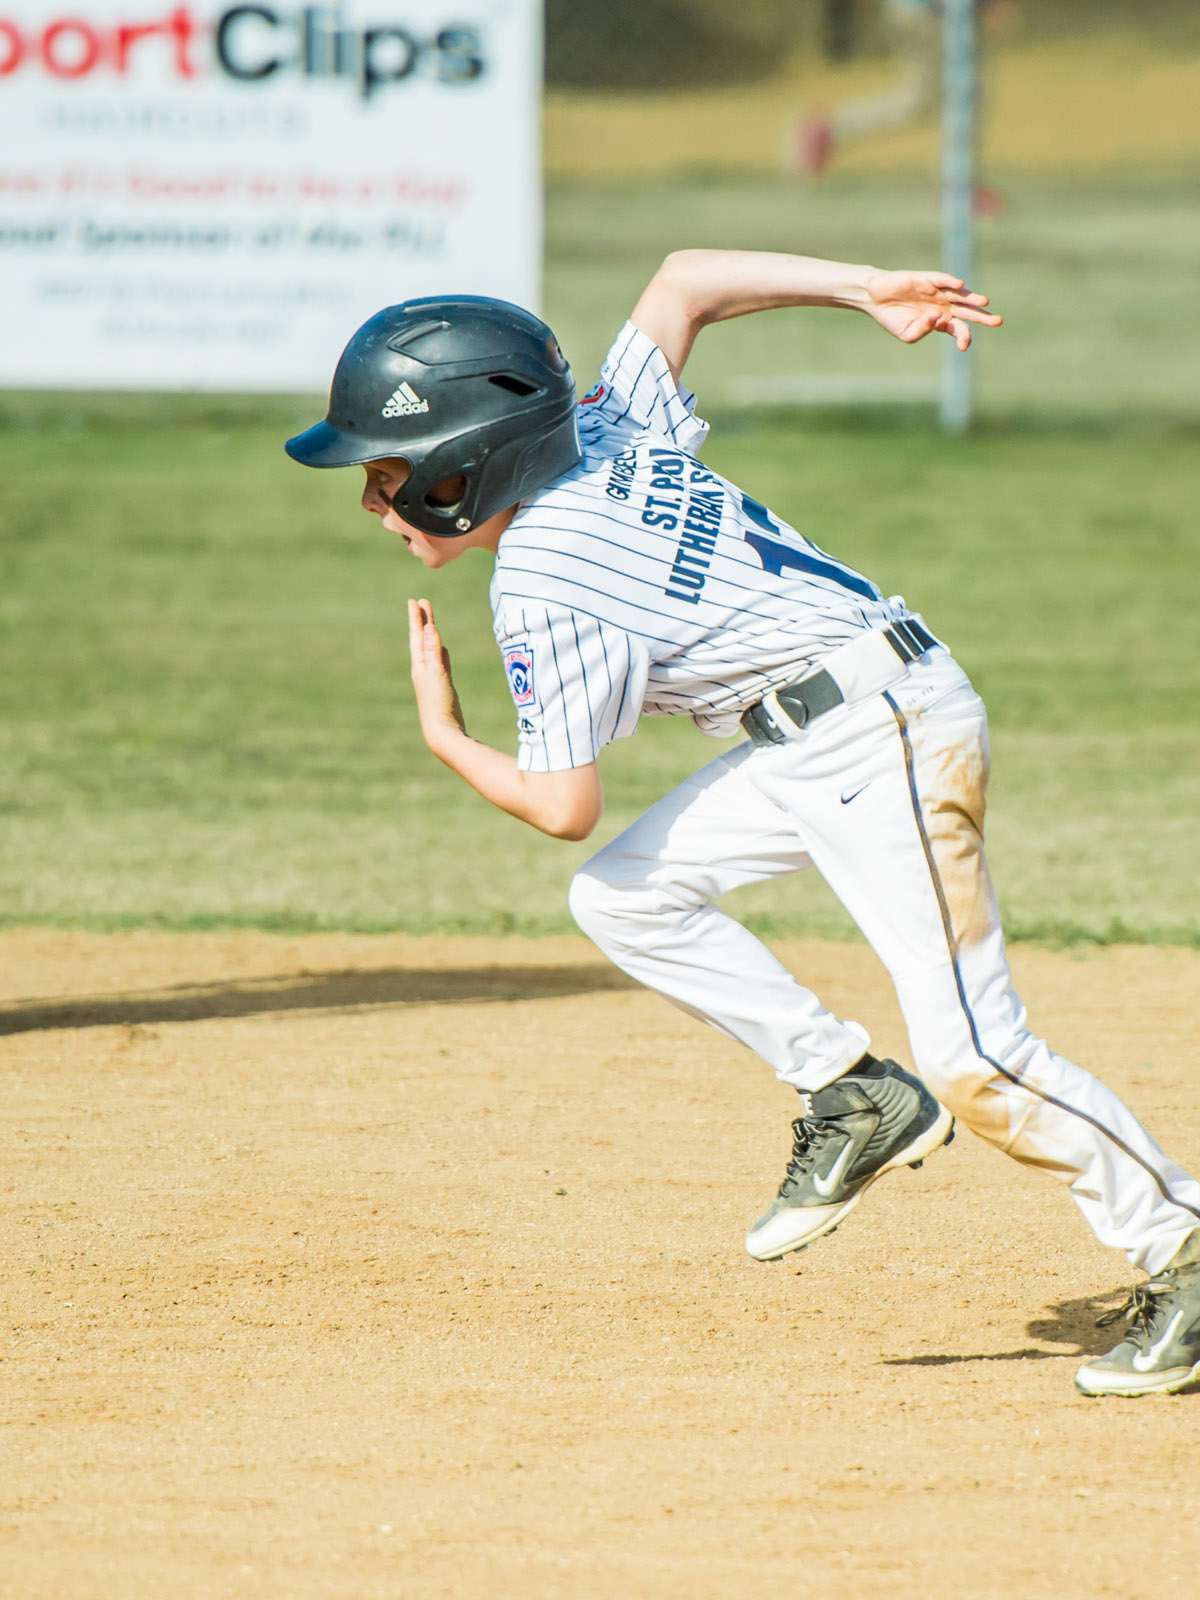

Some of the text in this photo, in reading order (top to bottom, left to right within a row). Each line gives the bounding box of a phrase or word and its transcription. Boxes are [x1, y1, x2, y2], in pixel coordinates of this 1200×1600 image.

[382, 399, 429, 418] adidas
[641, 495, 682, 531] ST.
[664, 488, 725, 605] LUTHERAN
